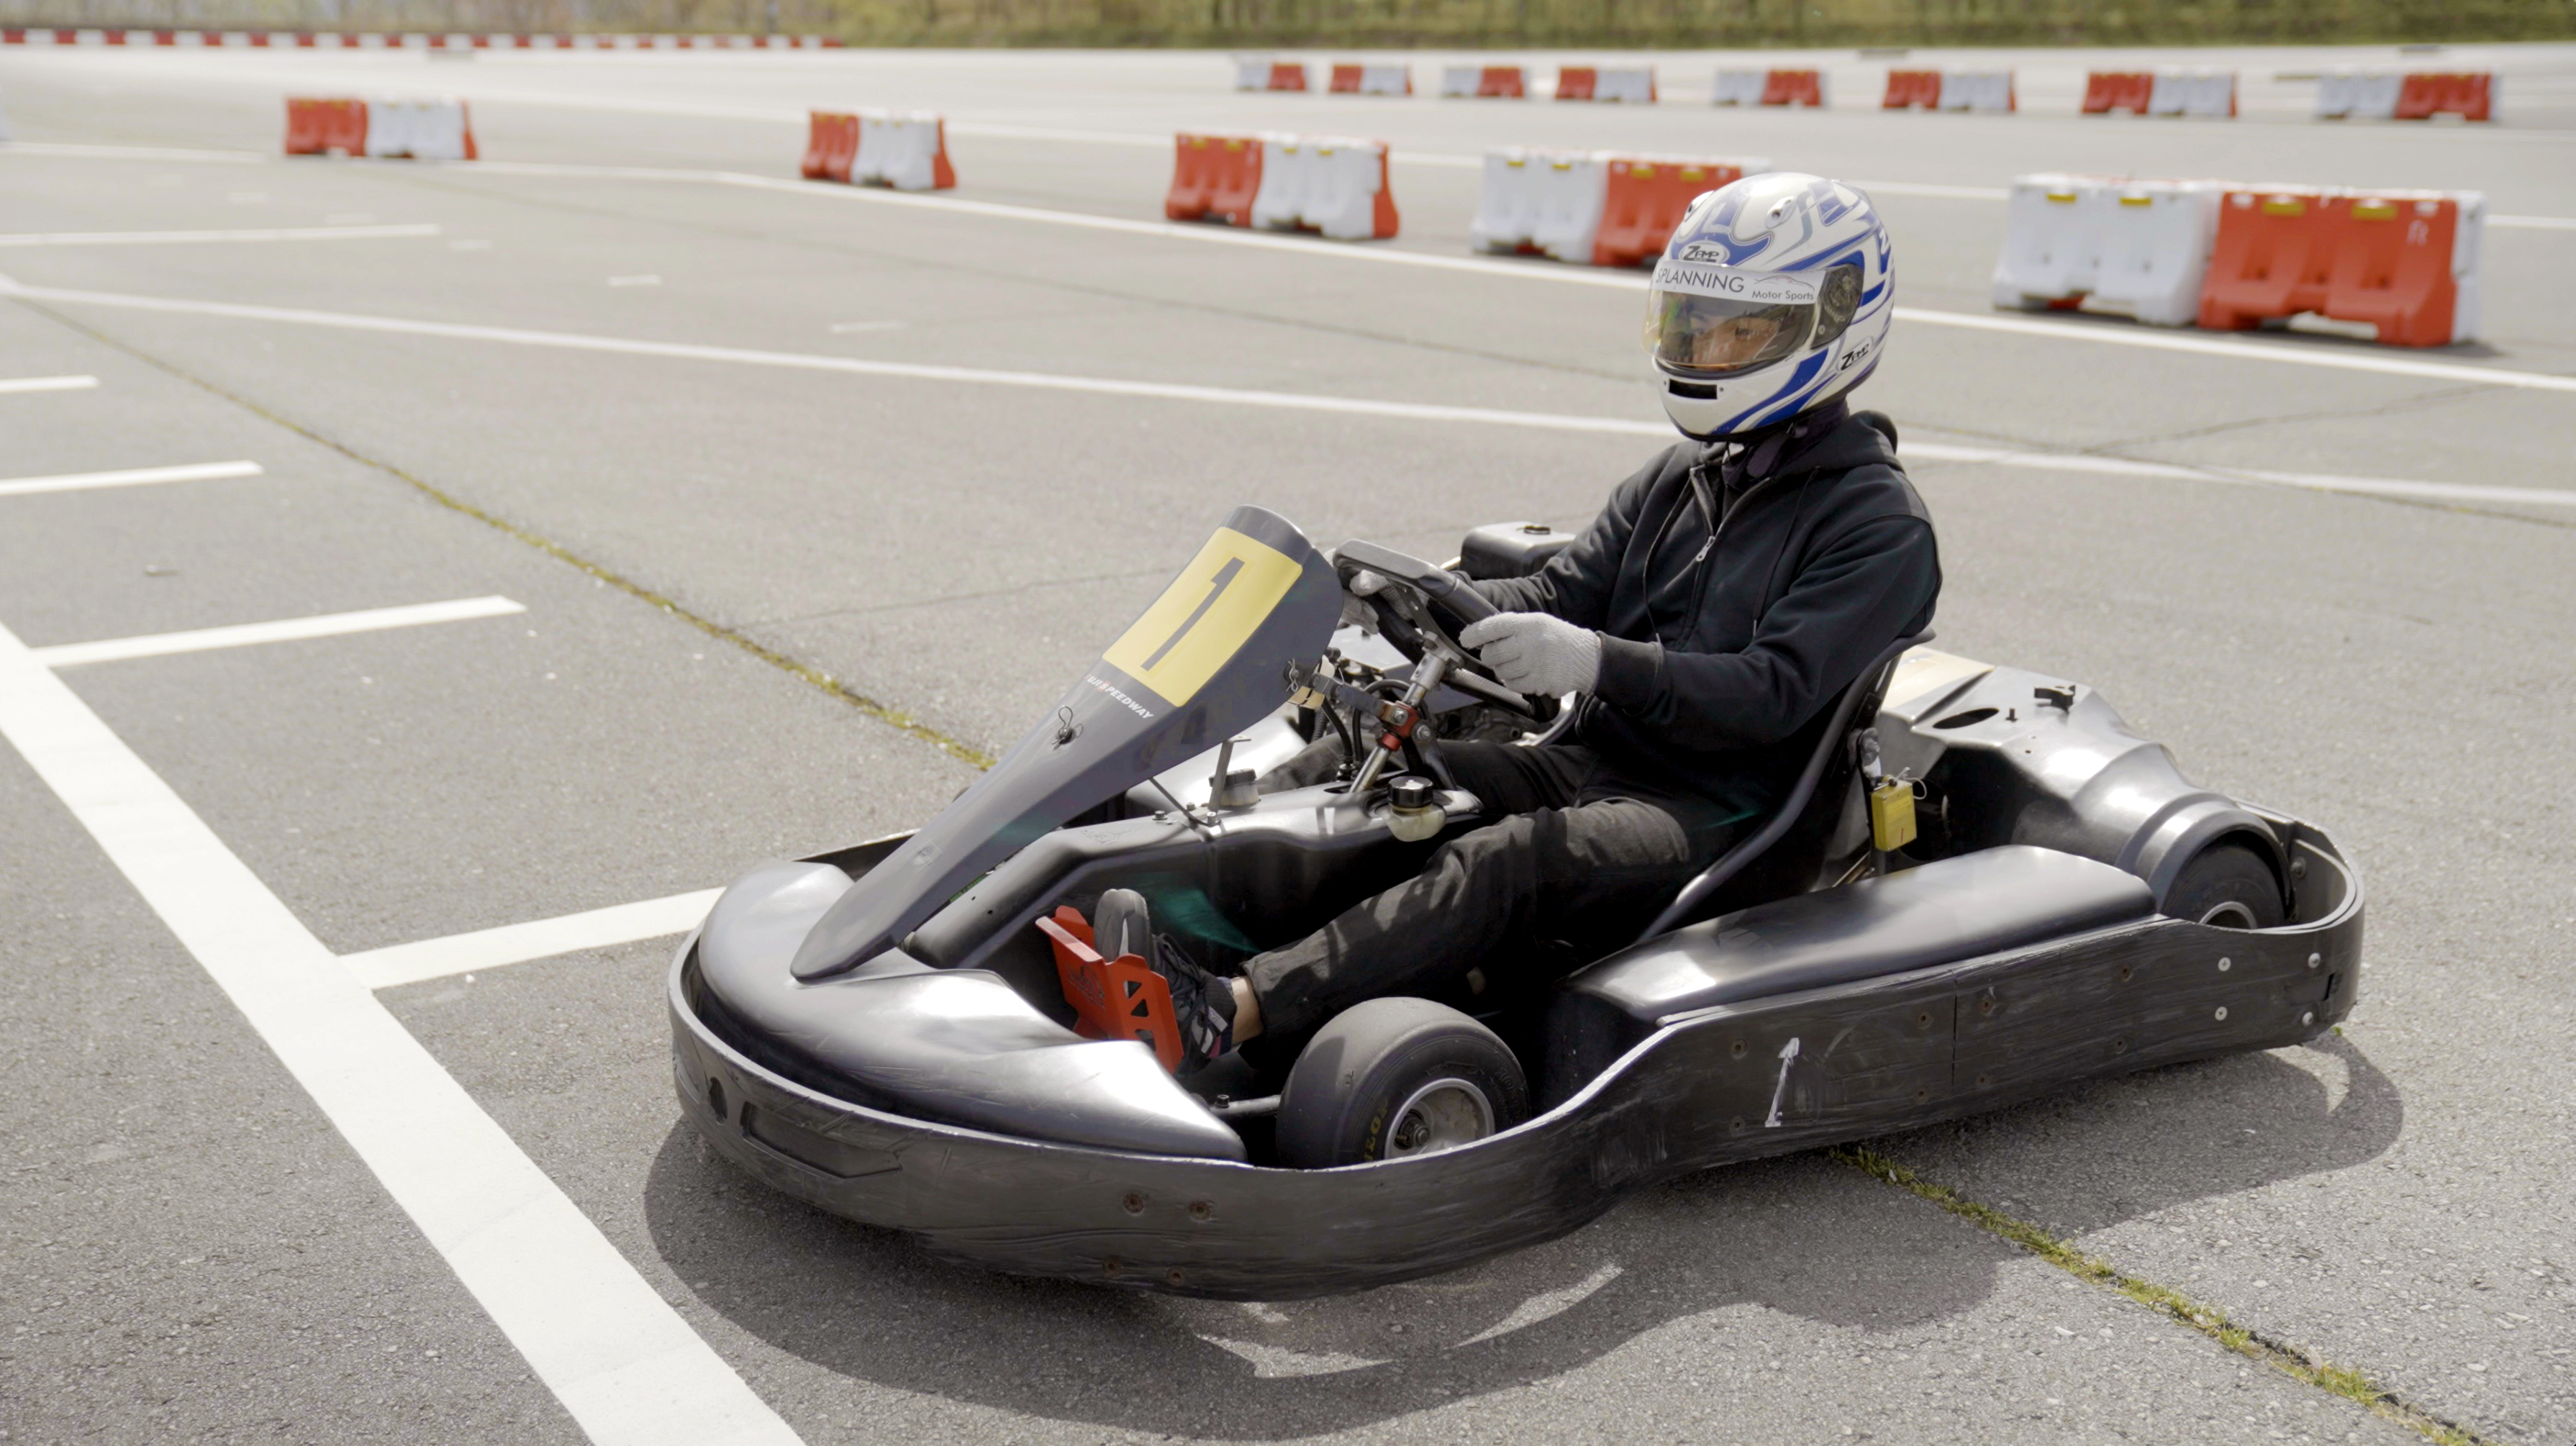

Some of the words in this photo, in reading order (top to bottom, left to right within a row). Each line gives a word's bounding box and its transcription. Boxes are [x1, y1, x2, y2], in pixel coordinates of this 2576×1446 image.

[1682, 245, 1720, 263] ZAMP
[1752, 290, 1782, 299] Motor
[1785, 290, 1815, 301] Sports
[1140, 556, 1246, 672] 1
[1097, 681, 1154, 719] SPEEDWAY
[1764, 1037, 1800, 1128] 1
